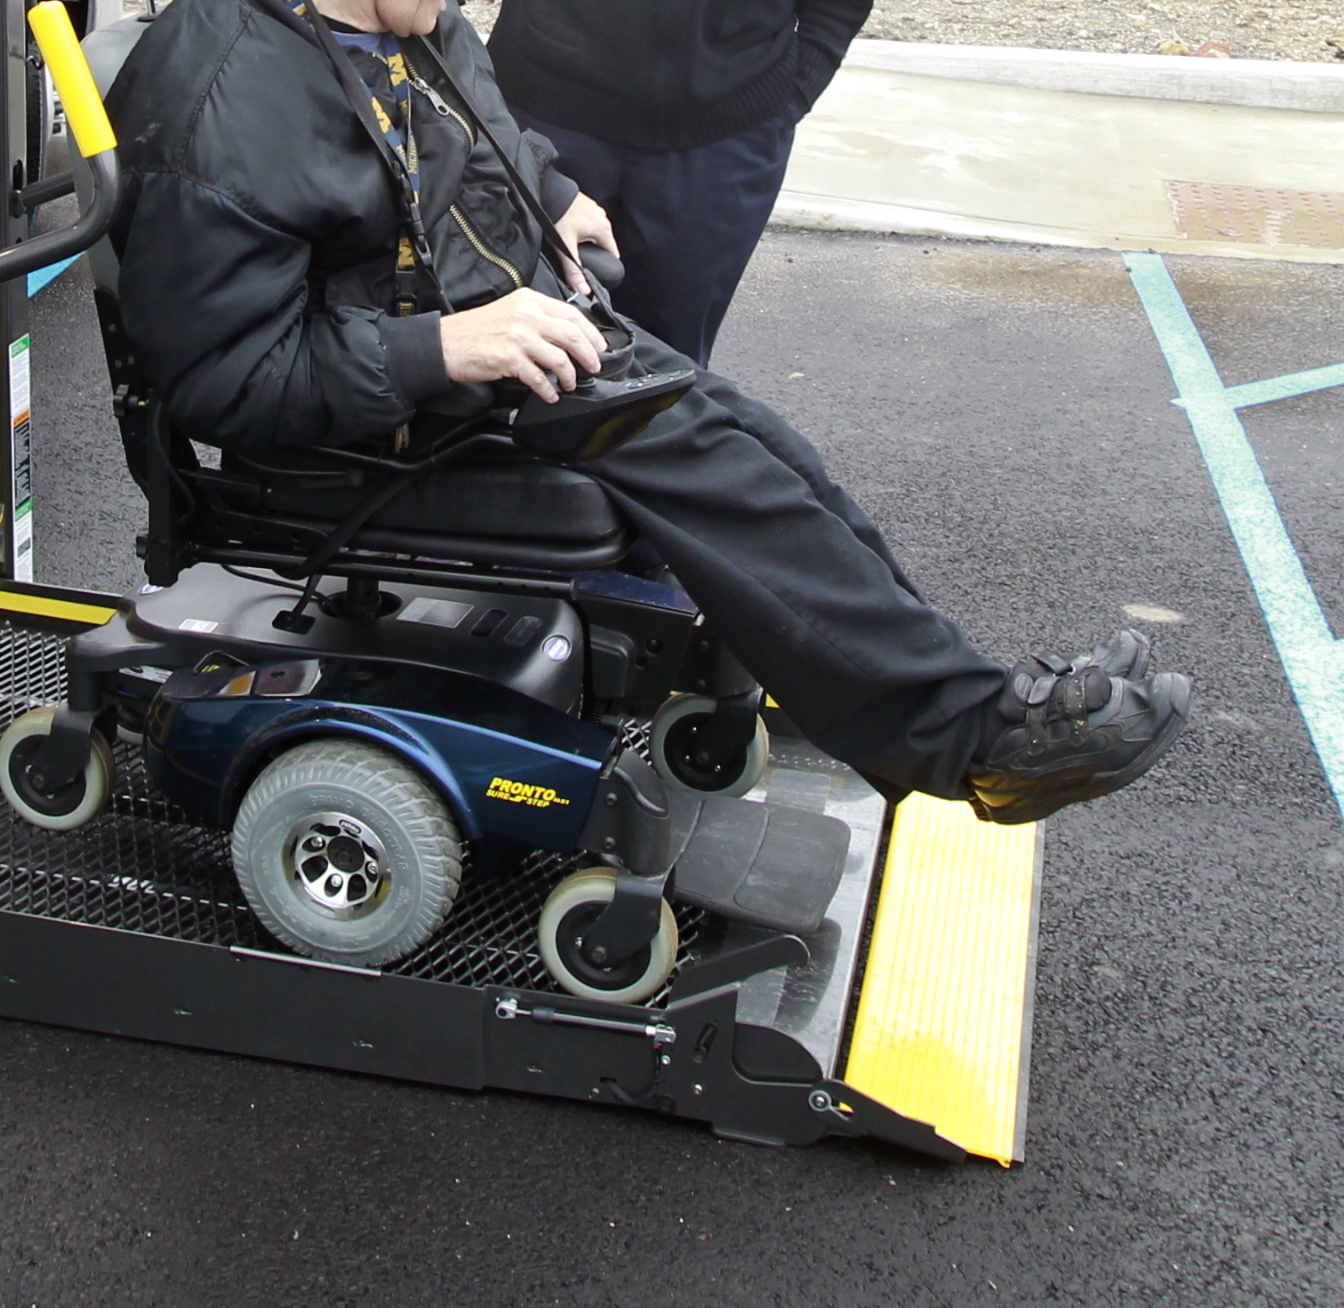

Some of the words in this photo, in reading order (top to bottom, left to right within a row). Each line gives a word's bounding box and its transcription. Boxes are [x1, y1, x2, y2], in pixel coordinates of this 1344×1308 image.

[486, 789, 510, 800] SURE
[526, 797, 550, 808] STEP
[489, 777, 556, 801] PRONTO
